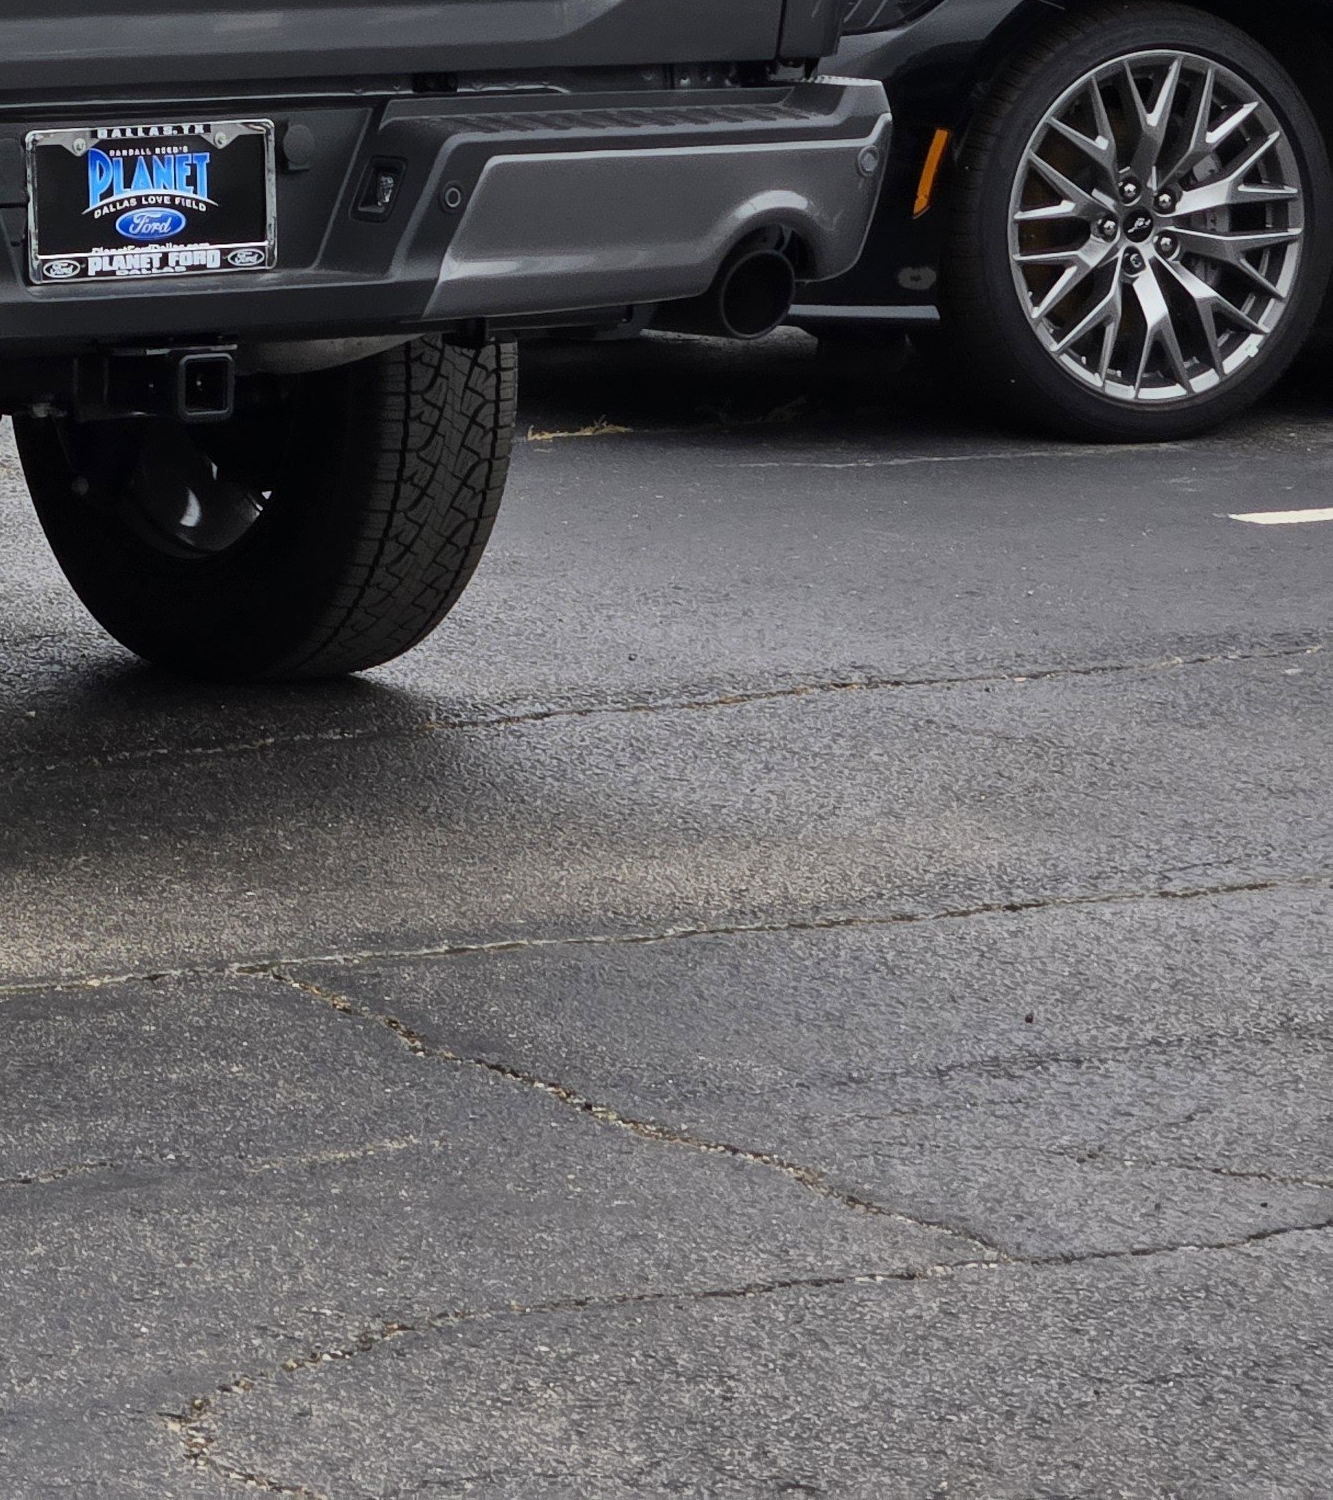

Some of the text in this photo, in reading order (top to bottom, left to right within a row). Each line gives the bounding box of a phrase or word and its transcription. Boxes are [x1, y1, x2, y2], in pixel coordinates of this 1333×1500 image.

[109, 145, 188, 157] RANDALL REED'S
[88, 147, 210, 210] PLANET
[94, 196, 207, 219] DALLAS LOVE FIELD
[129, 211, 173, 234] Ford
[88, 249, 221, 276] PLANET FORD
